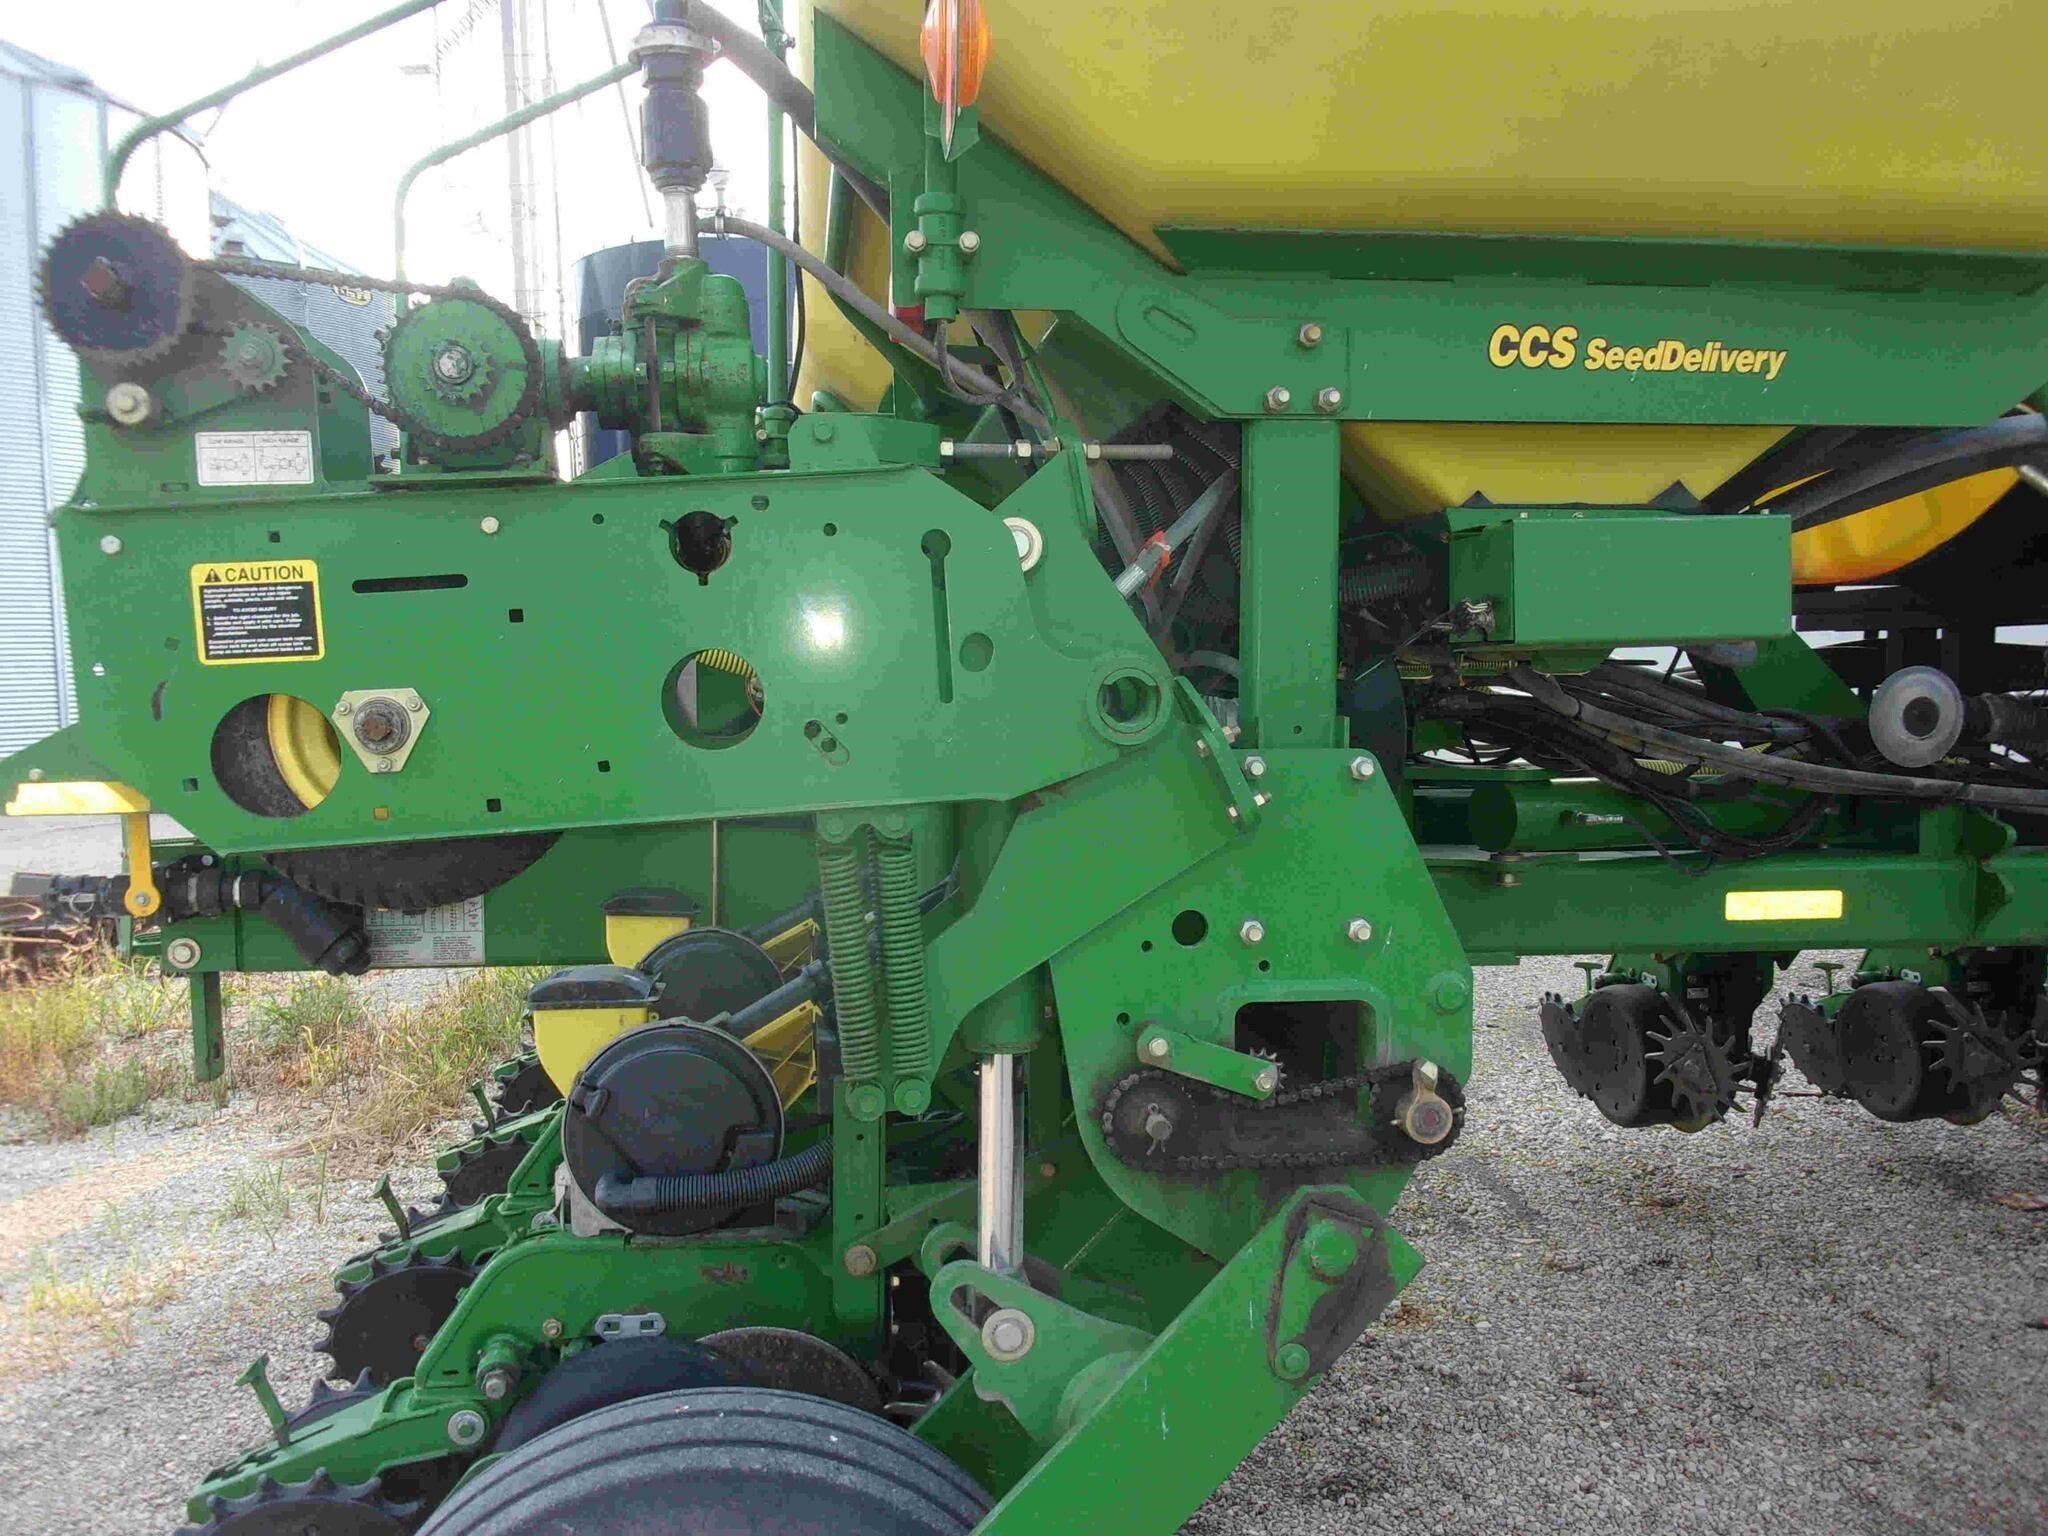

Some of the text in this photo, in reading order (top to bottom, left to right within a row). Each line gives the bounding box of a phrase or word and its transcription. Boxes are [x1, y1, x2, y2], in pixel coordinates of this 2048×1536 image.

[1488, 323, 1788, 381] CCS SeedDelivery
[225, 566, 304, 582] CAUTION
